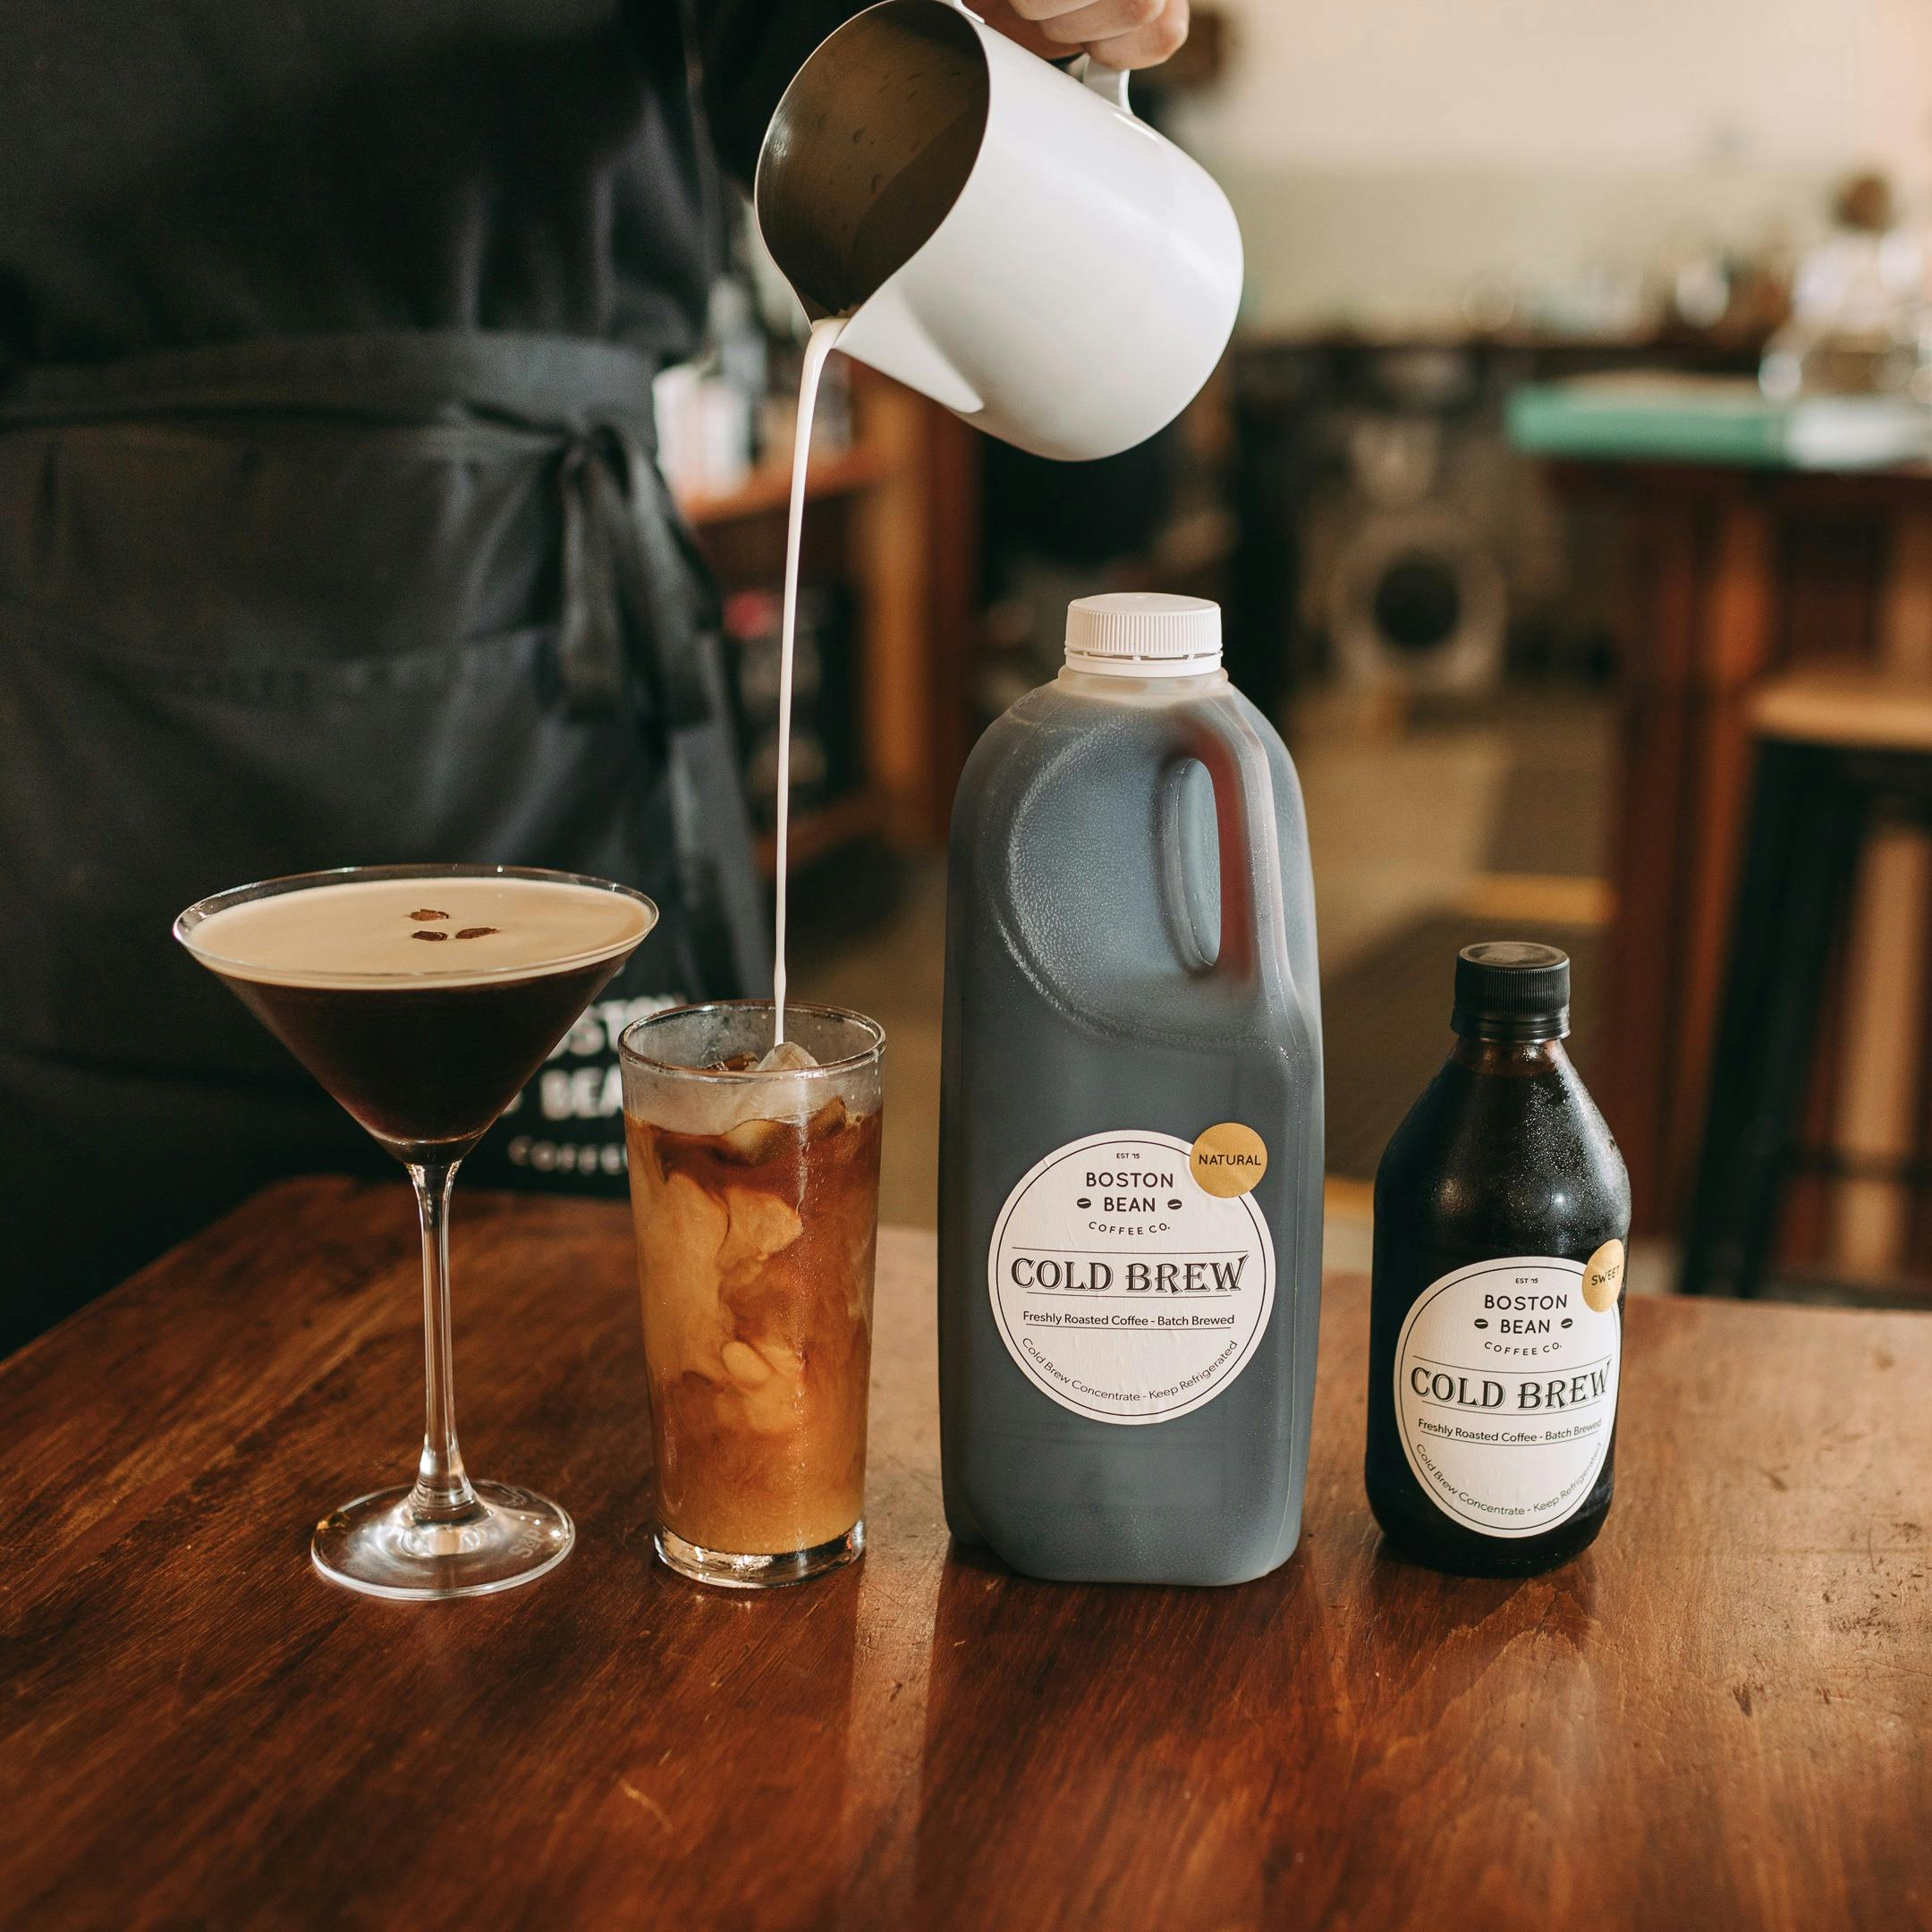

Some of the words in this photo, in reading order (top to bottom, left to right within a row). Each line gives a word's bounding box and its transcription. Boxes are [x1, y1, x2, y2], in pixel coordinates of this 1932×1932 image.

[541, 1066, 624, 1122] BEA
[1199, 1154, 1262, 1165] NATURAL
[1085, 1172, 1174, 1189] BOSTON
[1104, 1197, 1156, 1212] BEAN
[1089, 1221, 1144, 1235] COFFEE
[1148, 1222, 1171, 1233] CO.
[1011, 1258, 1114, 1292] COLD
[1124, 1253, 1250, 1295] BREW
[1590, 1265, 1621, 1286] SWEET
[1484, 1294, 1567, 1311] BOSTON
[1022, 1310, 1063, 1326] Freshly
[1064, 1313, 1109, 1326] Roasted
[1111, 1315, 1149, 1326] Coffee
[1157, 1315, 1189, 1326] Batch
[1191, 1314, 1234, 1326] Brewed
[1500, 1318, 1550, 1335] BEAN
[1484, 1342, 1538, 1356] COFFEE
[1542, 1342, 1563, 1353] CO.
[1022, 1337, 1046, 1364] Cold
[1044, 1361, 1071, 1384] Brew
[1072, 1379, 1140, 1402] Concentrate
[1148, 1386, 1179, 1400] Keep
[1179, 1340, 1238, 1391] Refrigerated
[1411, 1367, 1506, 1409] COLD
[1517, 1358, 1613, 1411] BREW
[1418, 1418, 1453, 1436] Freshly
[1455, 1428, 1499, 1442] Roasted
[1501, 1432, 1538, 1442] Coffee
[1545, 1426, 1572, 1441] Batch
[1573, 1418, 1603, 1436] Brewed
[1416, 1444, 1436, 1471] Cold
[1433, 1470, 1459, 1495] Brew
[1459, 1491, 1525, 1515] Concentrate
[1533, 1496, 1560, 1513] Keep
